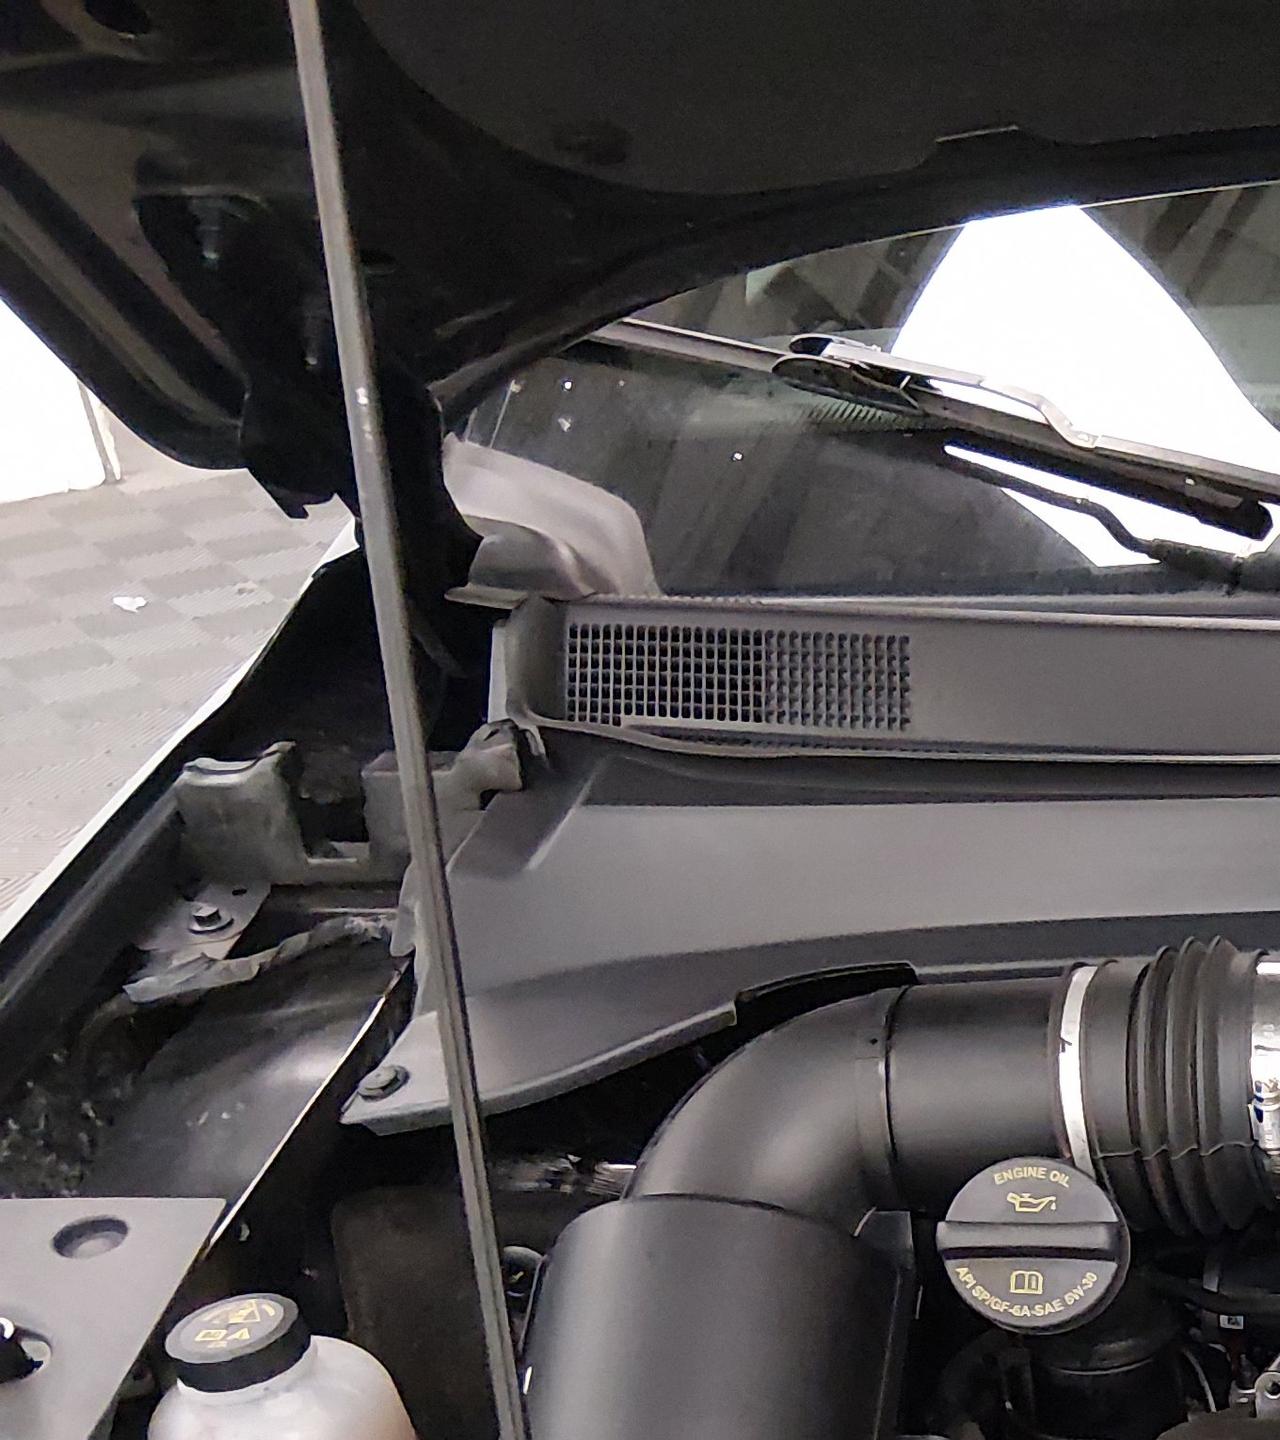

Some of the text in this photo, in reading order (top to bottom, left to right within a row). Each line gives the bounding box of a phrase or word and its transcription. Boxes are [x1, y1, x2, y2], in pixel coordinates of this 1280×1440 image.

[993, 1166, 1070, 1188] ENGINE OIL
[954, 1267, 977, 1289] API
